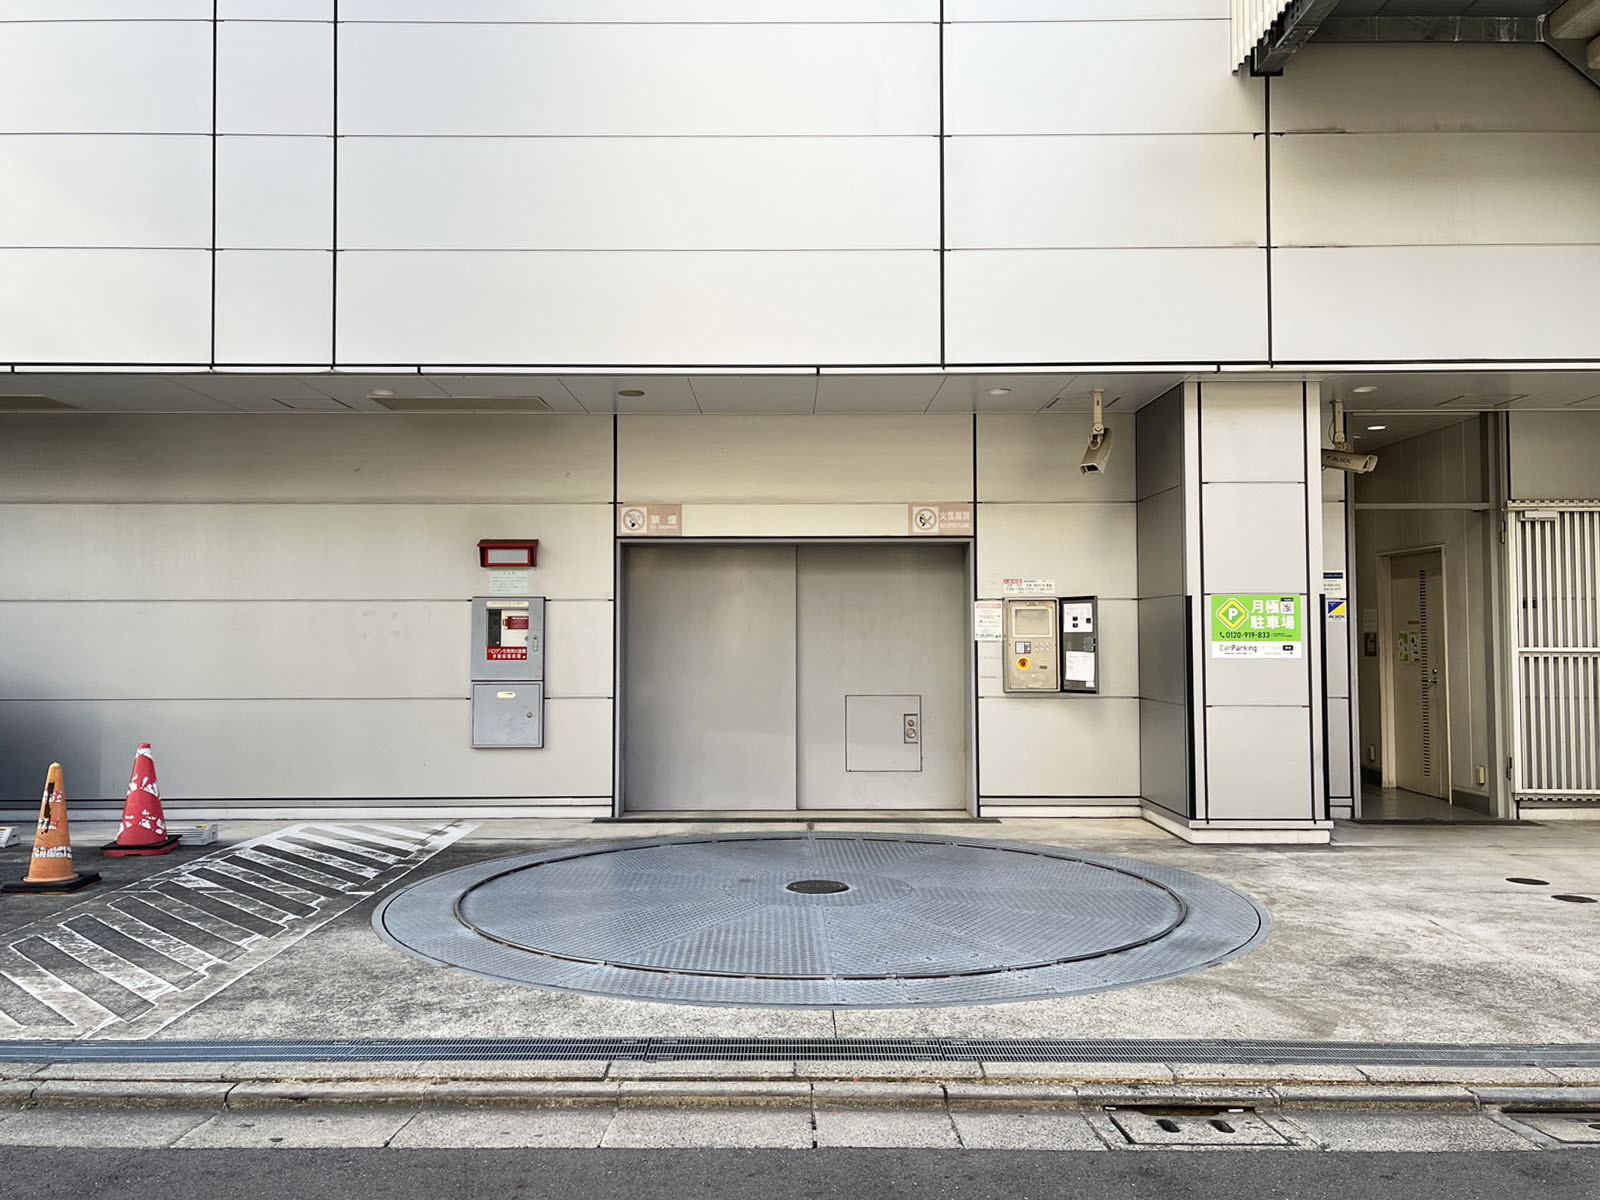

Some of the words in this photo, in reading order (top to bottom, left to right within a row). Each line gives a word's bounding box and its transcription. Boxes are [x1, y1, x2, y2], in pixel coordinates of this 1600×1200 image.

[1251, 599, 1280, 614] 月極
[1250, 615, 1295, 630] 駐車場
[1225, 631, 1271, 639] 0120-919-833
